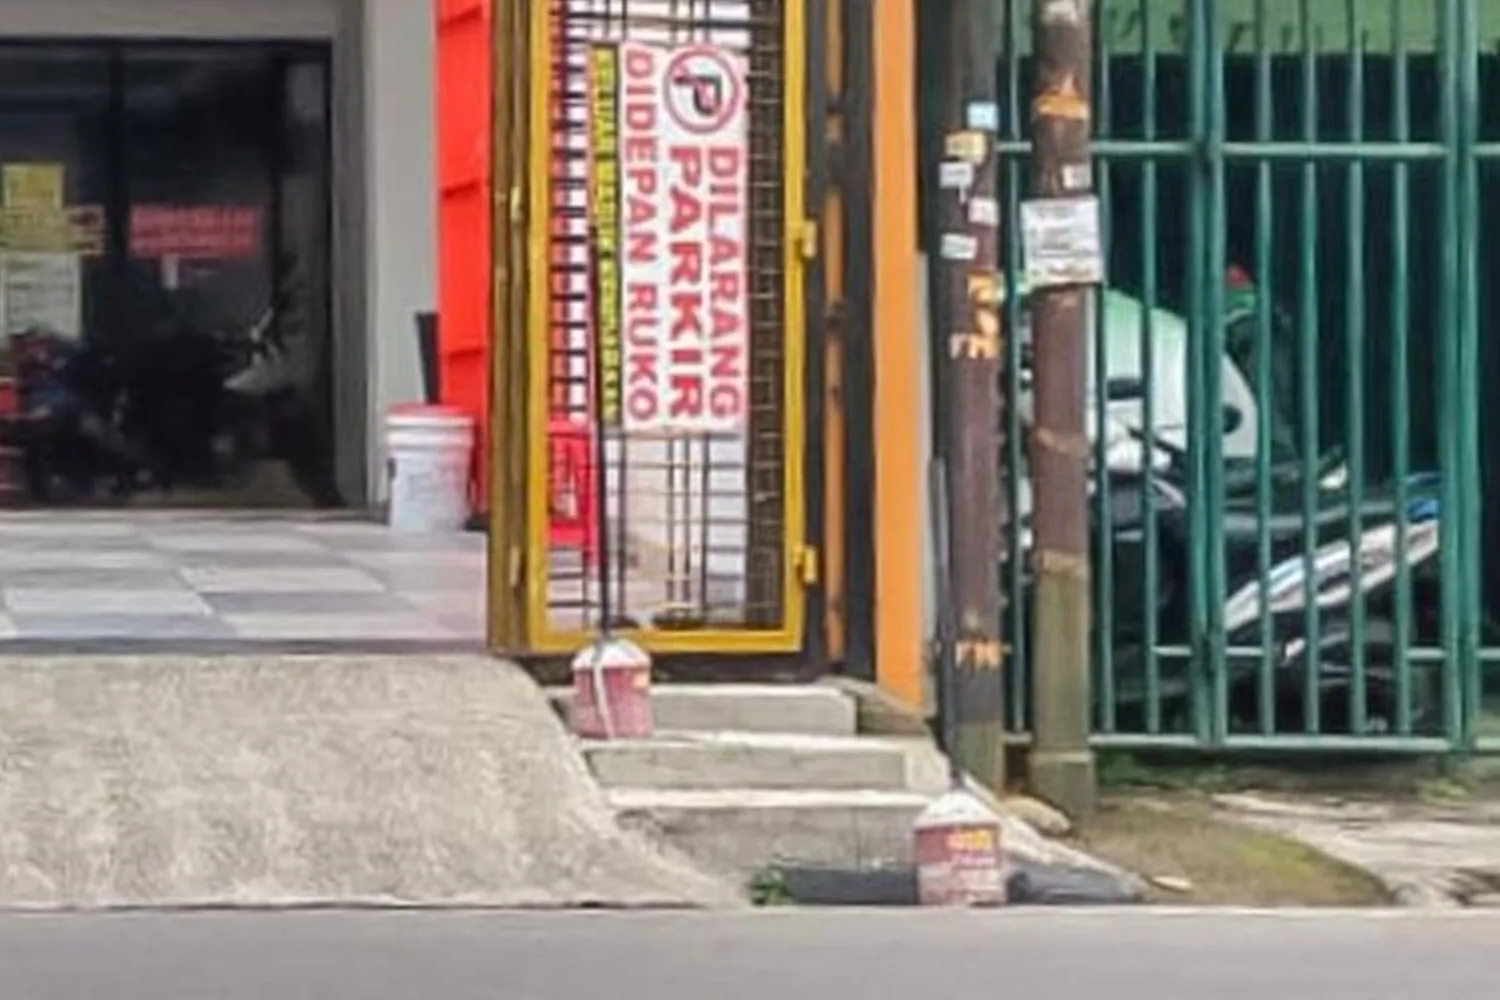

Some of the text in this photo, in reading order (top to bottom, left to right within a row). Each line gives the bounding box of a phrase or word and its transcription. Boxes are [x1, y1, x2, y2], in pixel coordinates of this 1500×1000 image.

[625, 49, 659, 422] DIDEPAN RUKO
[668, 146, 702, 419] PARKIR
[708, 147, 741, 419] DILARANG
